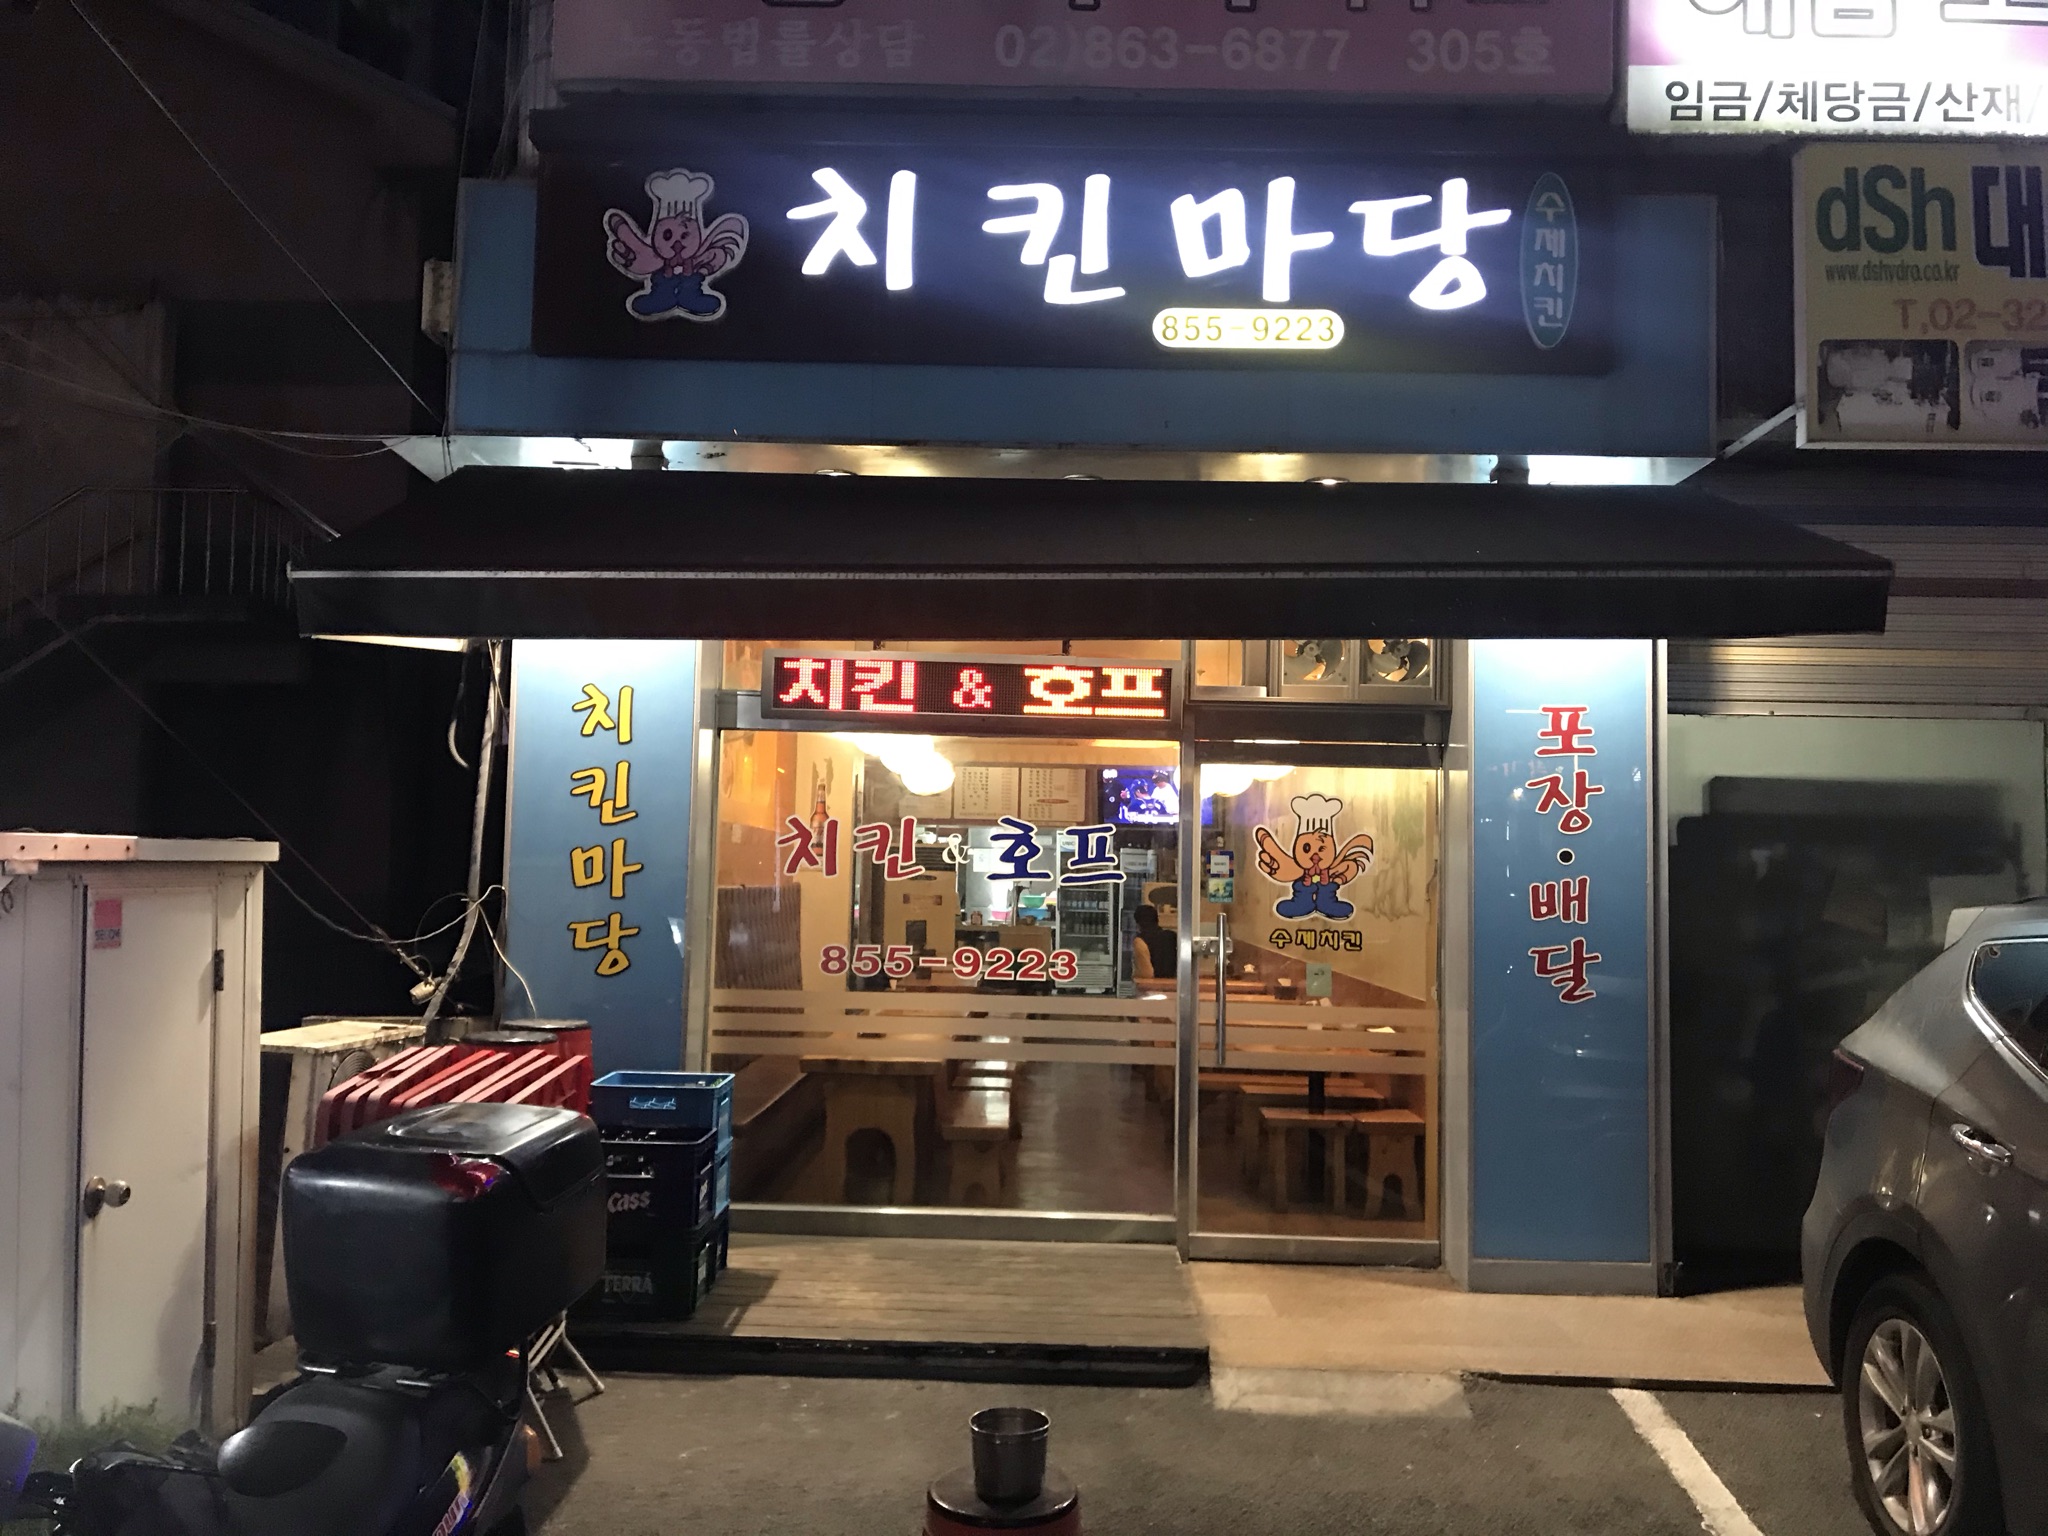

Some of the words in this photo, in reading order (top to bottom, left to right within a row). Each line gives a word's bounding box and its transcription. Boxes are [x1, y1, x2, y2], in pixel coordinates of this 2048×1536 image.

[996, 26, 1350, 71] 02)863-6877
[1408, 29, 1555, 75] 305호
[1816, 164, 1958, 254] dSh
[785, 167, 1513, 312] 치킨마당
[1533, 191, 1567, 328] 수제치킨
[1161, 315, 1336, 343] 855-9223
[779, 659, 917, 713] 치킨
[952, 669, 992, 709] &
[1023, 666, 1166, 716] 호프
[568, 683, 643, 977] 치킨마당
[775, 815, 924, 881] 치킨
[942, 832, 972, 866] &
[986, 815, 1127, 886] 호프
[819, 943, 1080, 983] 855-9223
[1269, 928, 1363, 952] 수제치킨
[608, 1191, 652, 1213] Cass
[604, 1275, 653, 1294] TERRA
